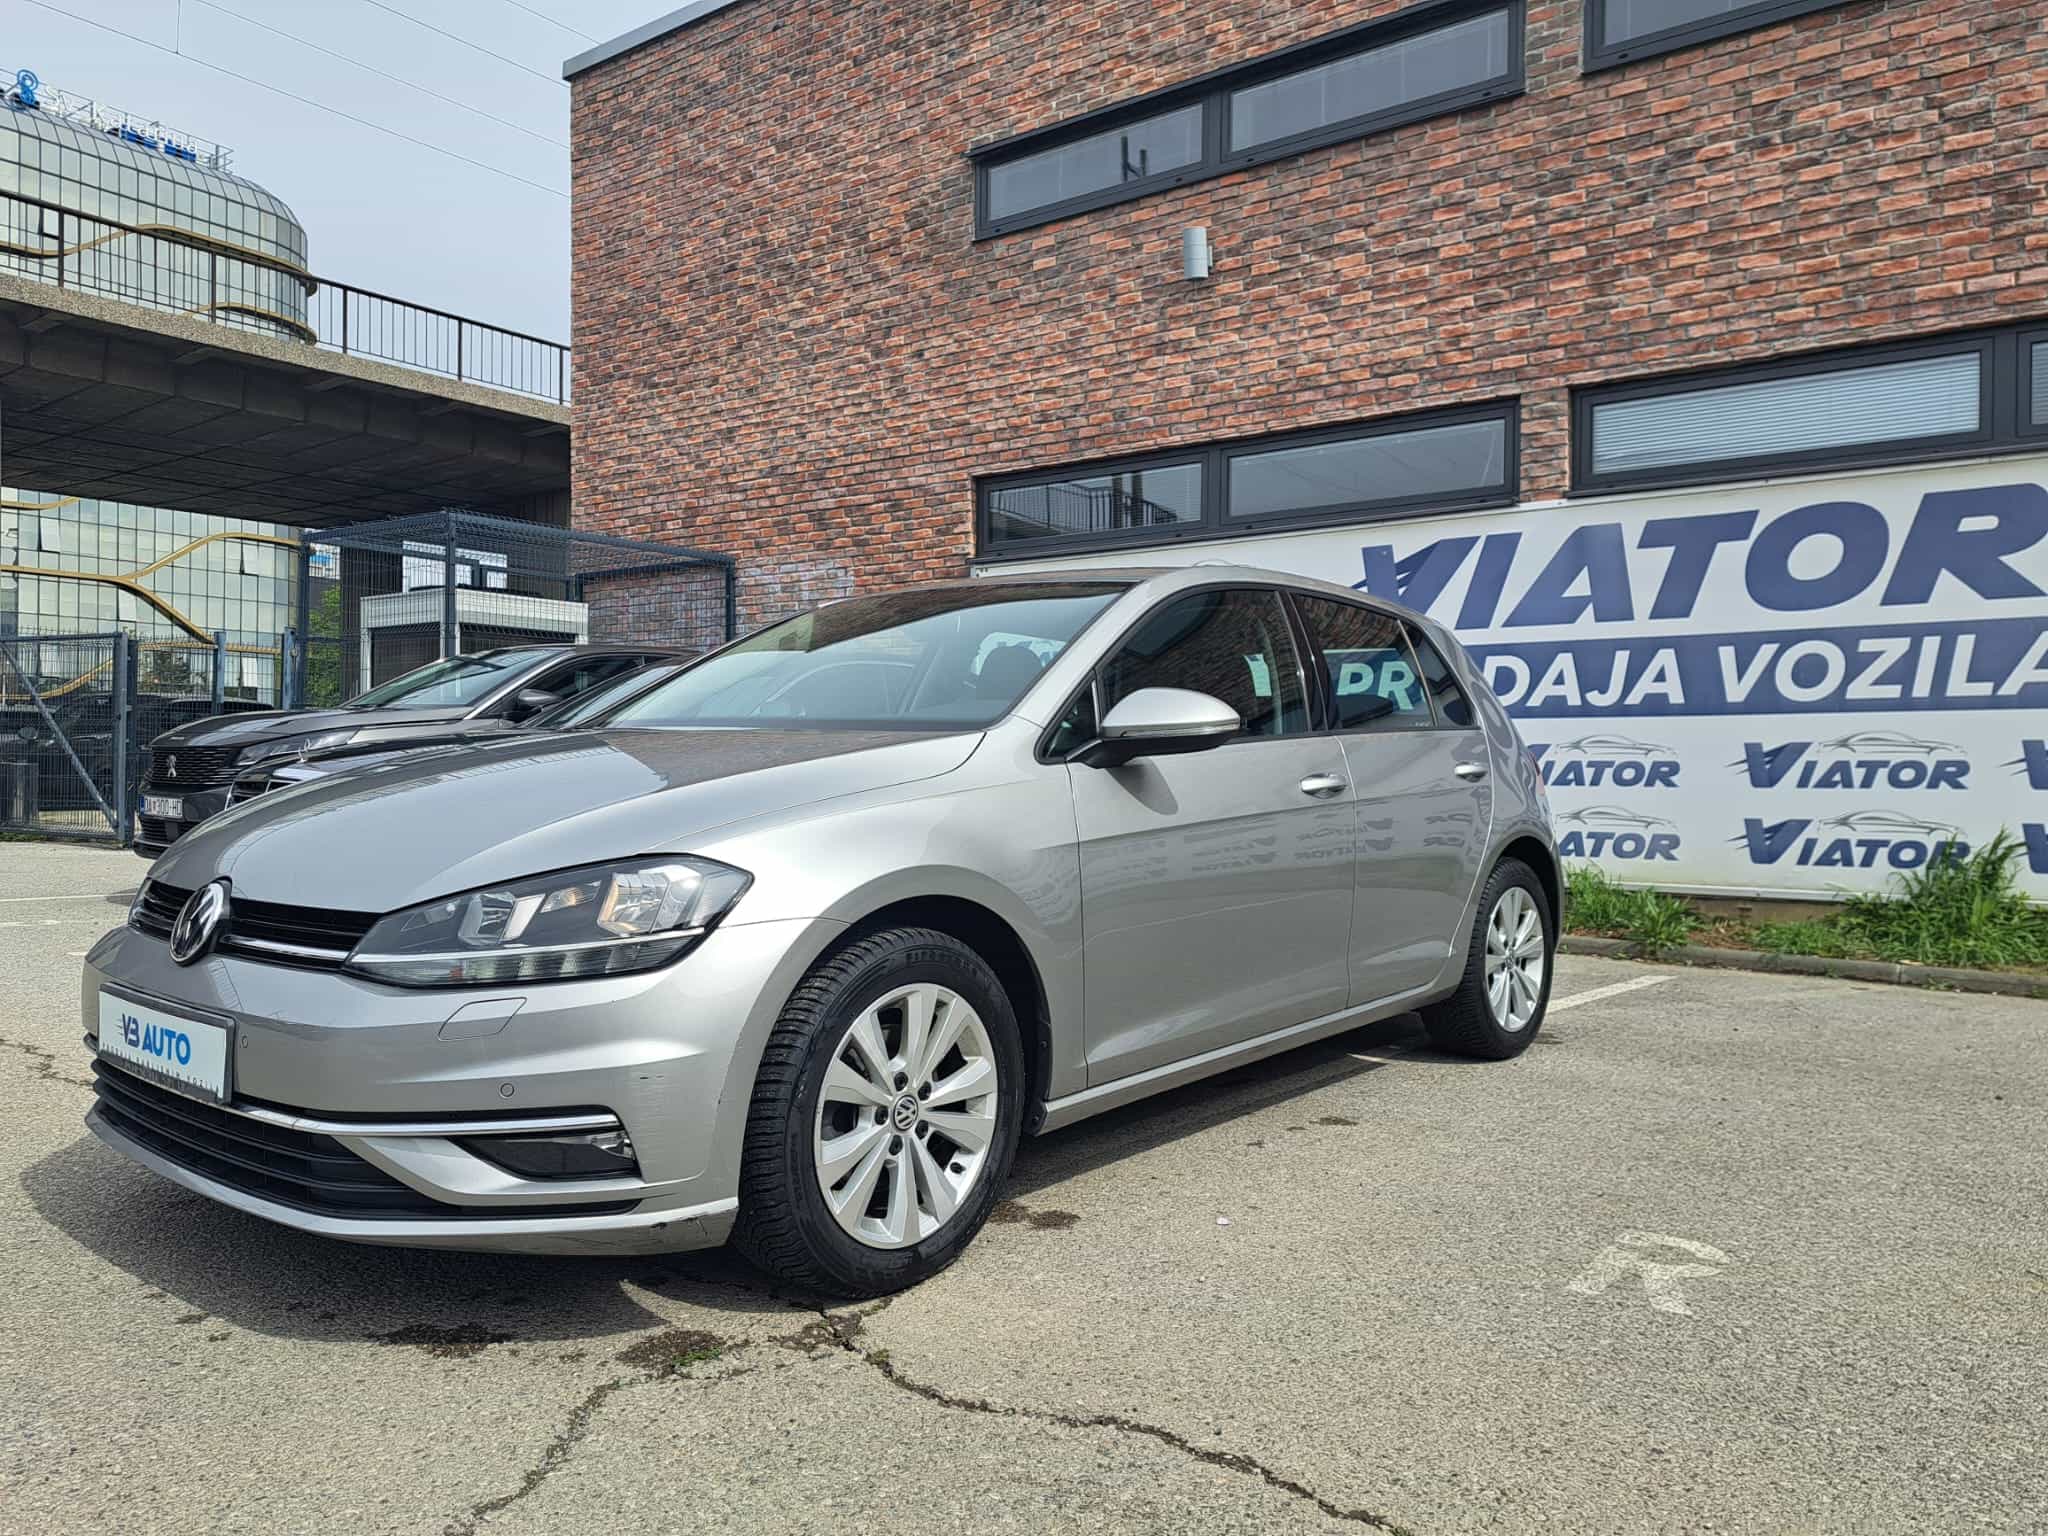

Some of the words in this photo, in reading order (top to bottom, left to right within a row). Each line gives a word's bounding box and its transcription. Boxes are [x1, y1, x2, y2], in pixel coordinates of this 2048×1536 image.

[1361, 482, 2048, 630] VIATOR
[1717, 630, 2048, 703] VOZILA
[1743, 742, 1971, 789] VIATOR
[1559, 830, 1681, 862] ATOR
[142, 1021, 192, 1066] AUTO
